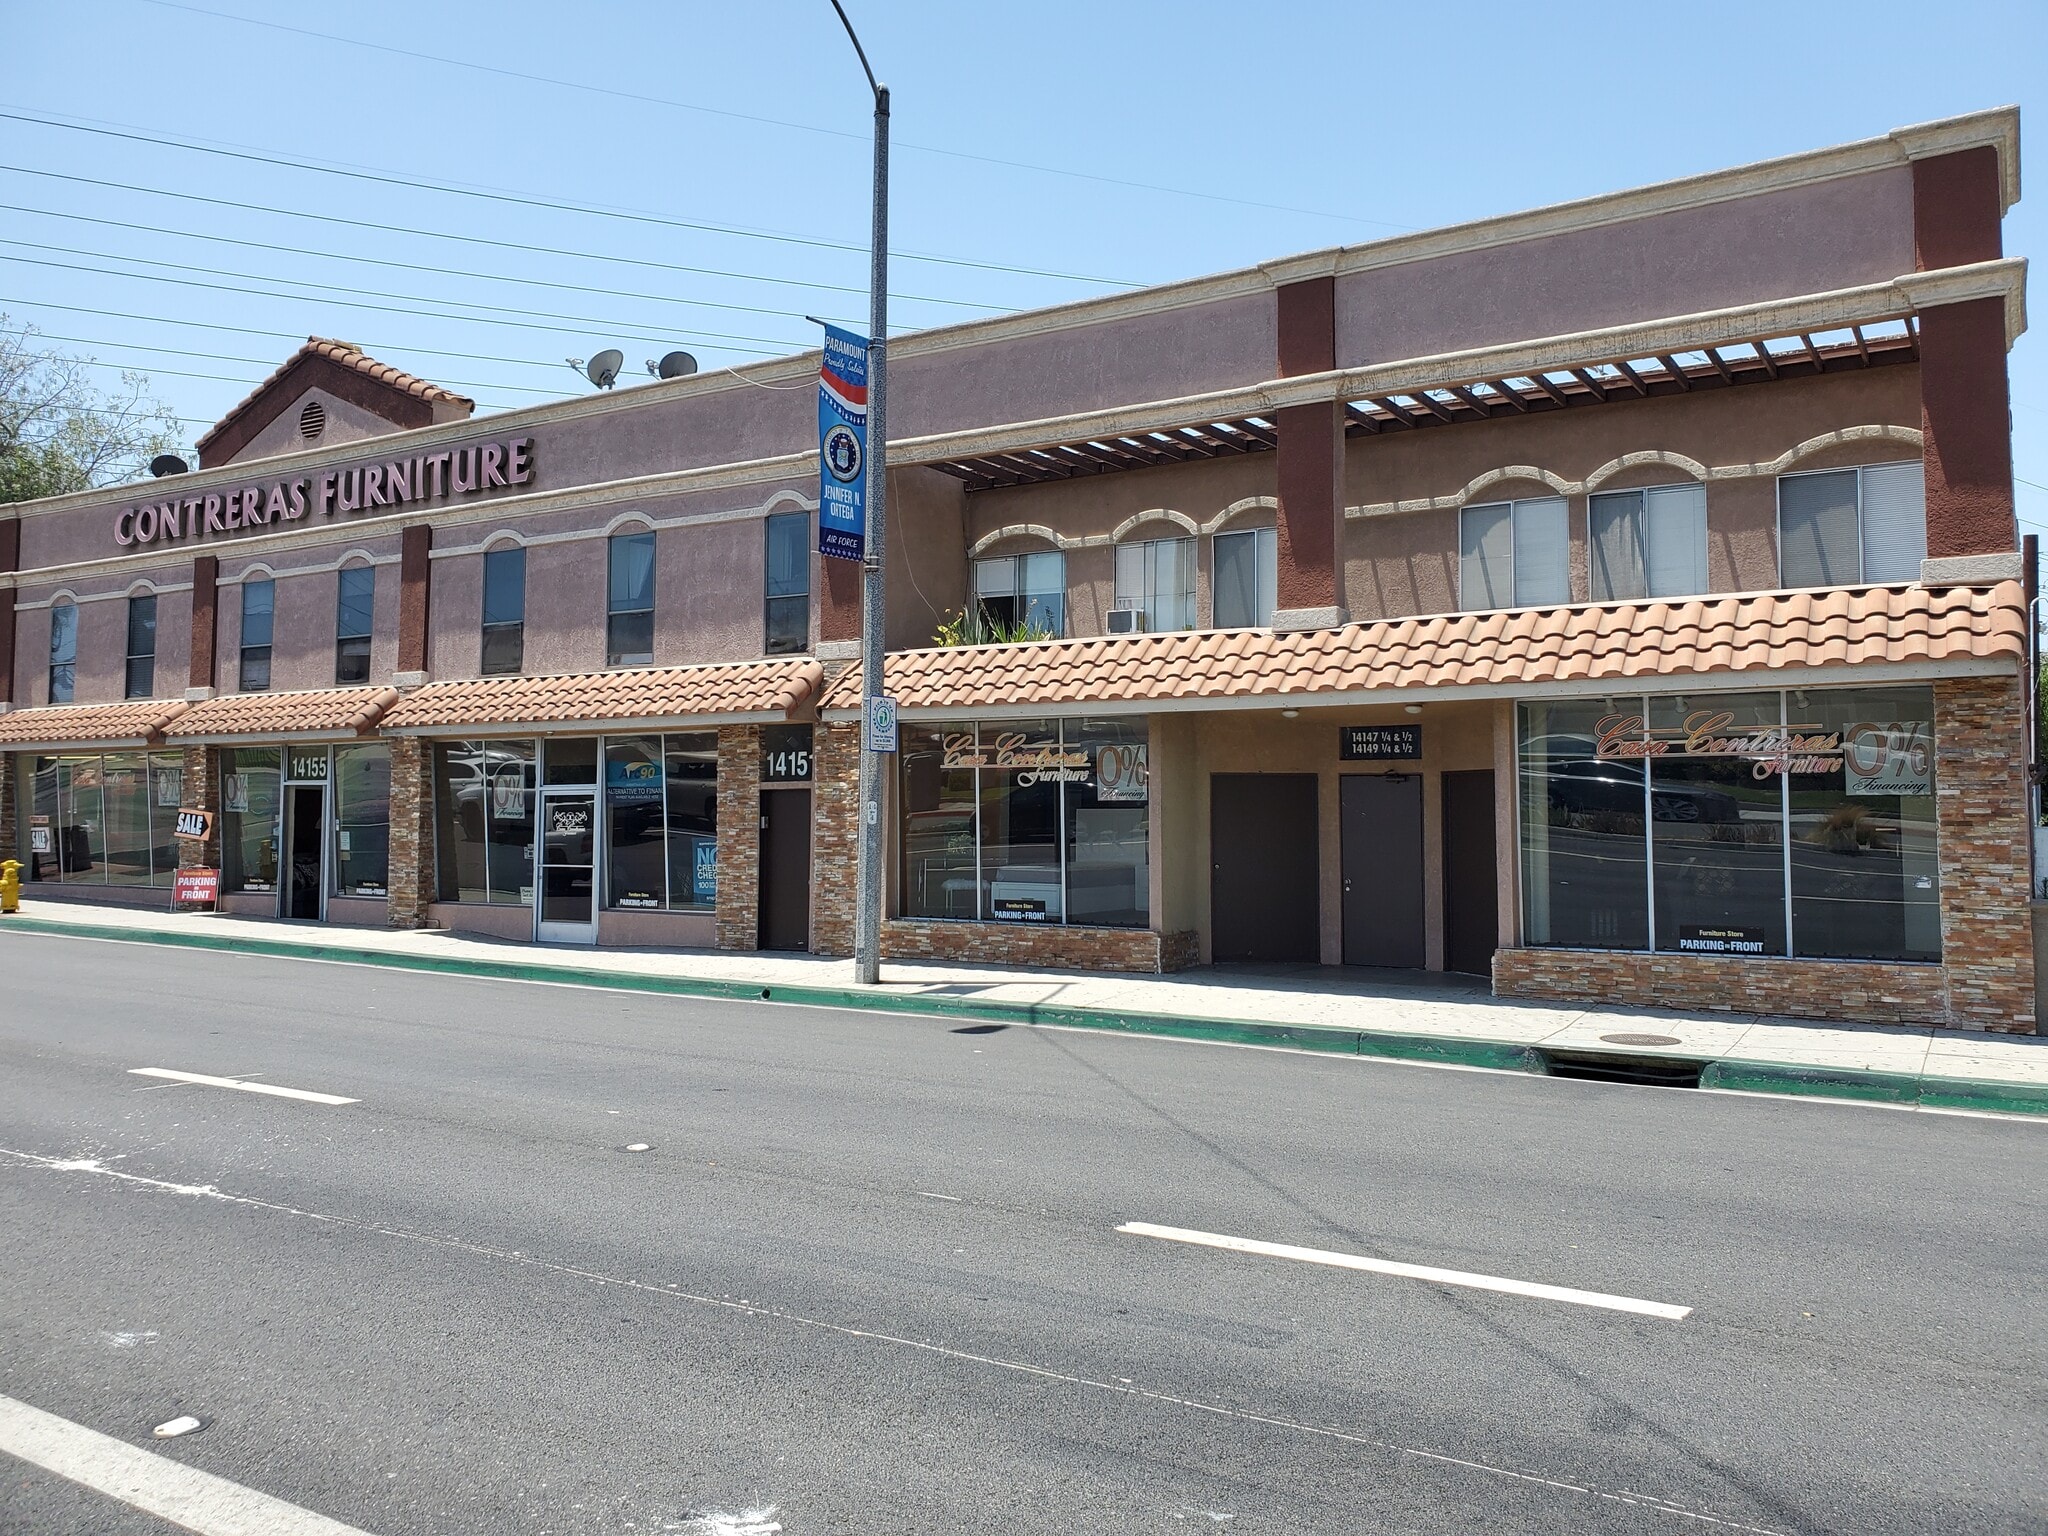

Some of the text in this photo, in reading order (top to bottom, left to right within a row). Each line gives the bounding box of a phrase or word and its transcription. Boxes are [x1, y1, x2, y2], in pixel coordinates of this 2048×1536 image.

[826, 336, 865, 361] PARAMOUNT
[824, 353, 845, 371] Proudly
[114, 438, 536, 546] CONTRERAS FURNITURE
[824, 485, 853, 504] JENNIFER
[830, 502, 854, 520] ORTEGA
[826, 535, 858, 548] AIR FORCE
[1352, 732, 1378, 742] 14147
[1393, 733, 1400, 741] &
[1595, 711, 1839, 755] Casa Contreras
[1352, 744, 1378, 753] 14149
[1393, 744, 1400, 753] &
[1846, 722, 1929, 776] 0%
[293, 757, 326, 777] 14155
[1097, 746, 1145, 787] 0%
[1852, 777, 1929, 794] Financing
[176, 812, 203, 835] SALE
[178, 877, 216, 886] PARKING
[181, 890, 210, 899] FRONT
[994, 911, 1022, 919] PARKING
[1025, 912, 1045, 920] FRONT
[1699, 929, 1744, 938] Furniture Store
[1680, 939, 1725, 951] PARKING
[1730, 941, 1763, 952] FRONT
